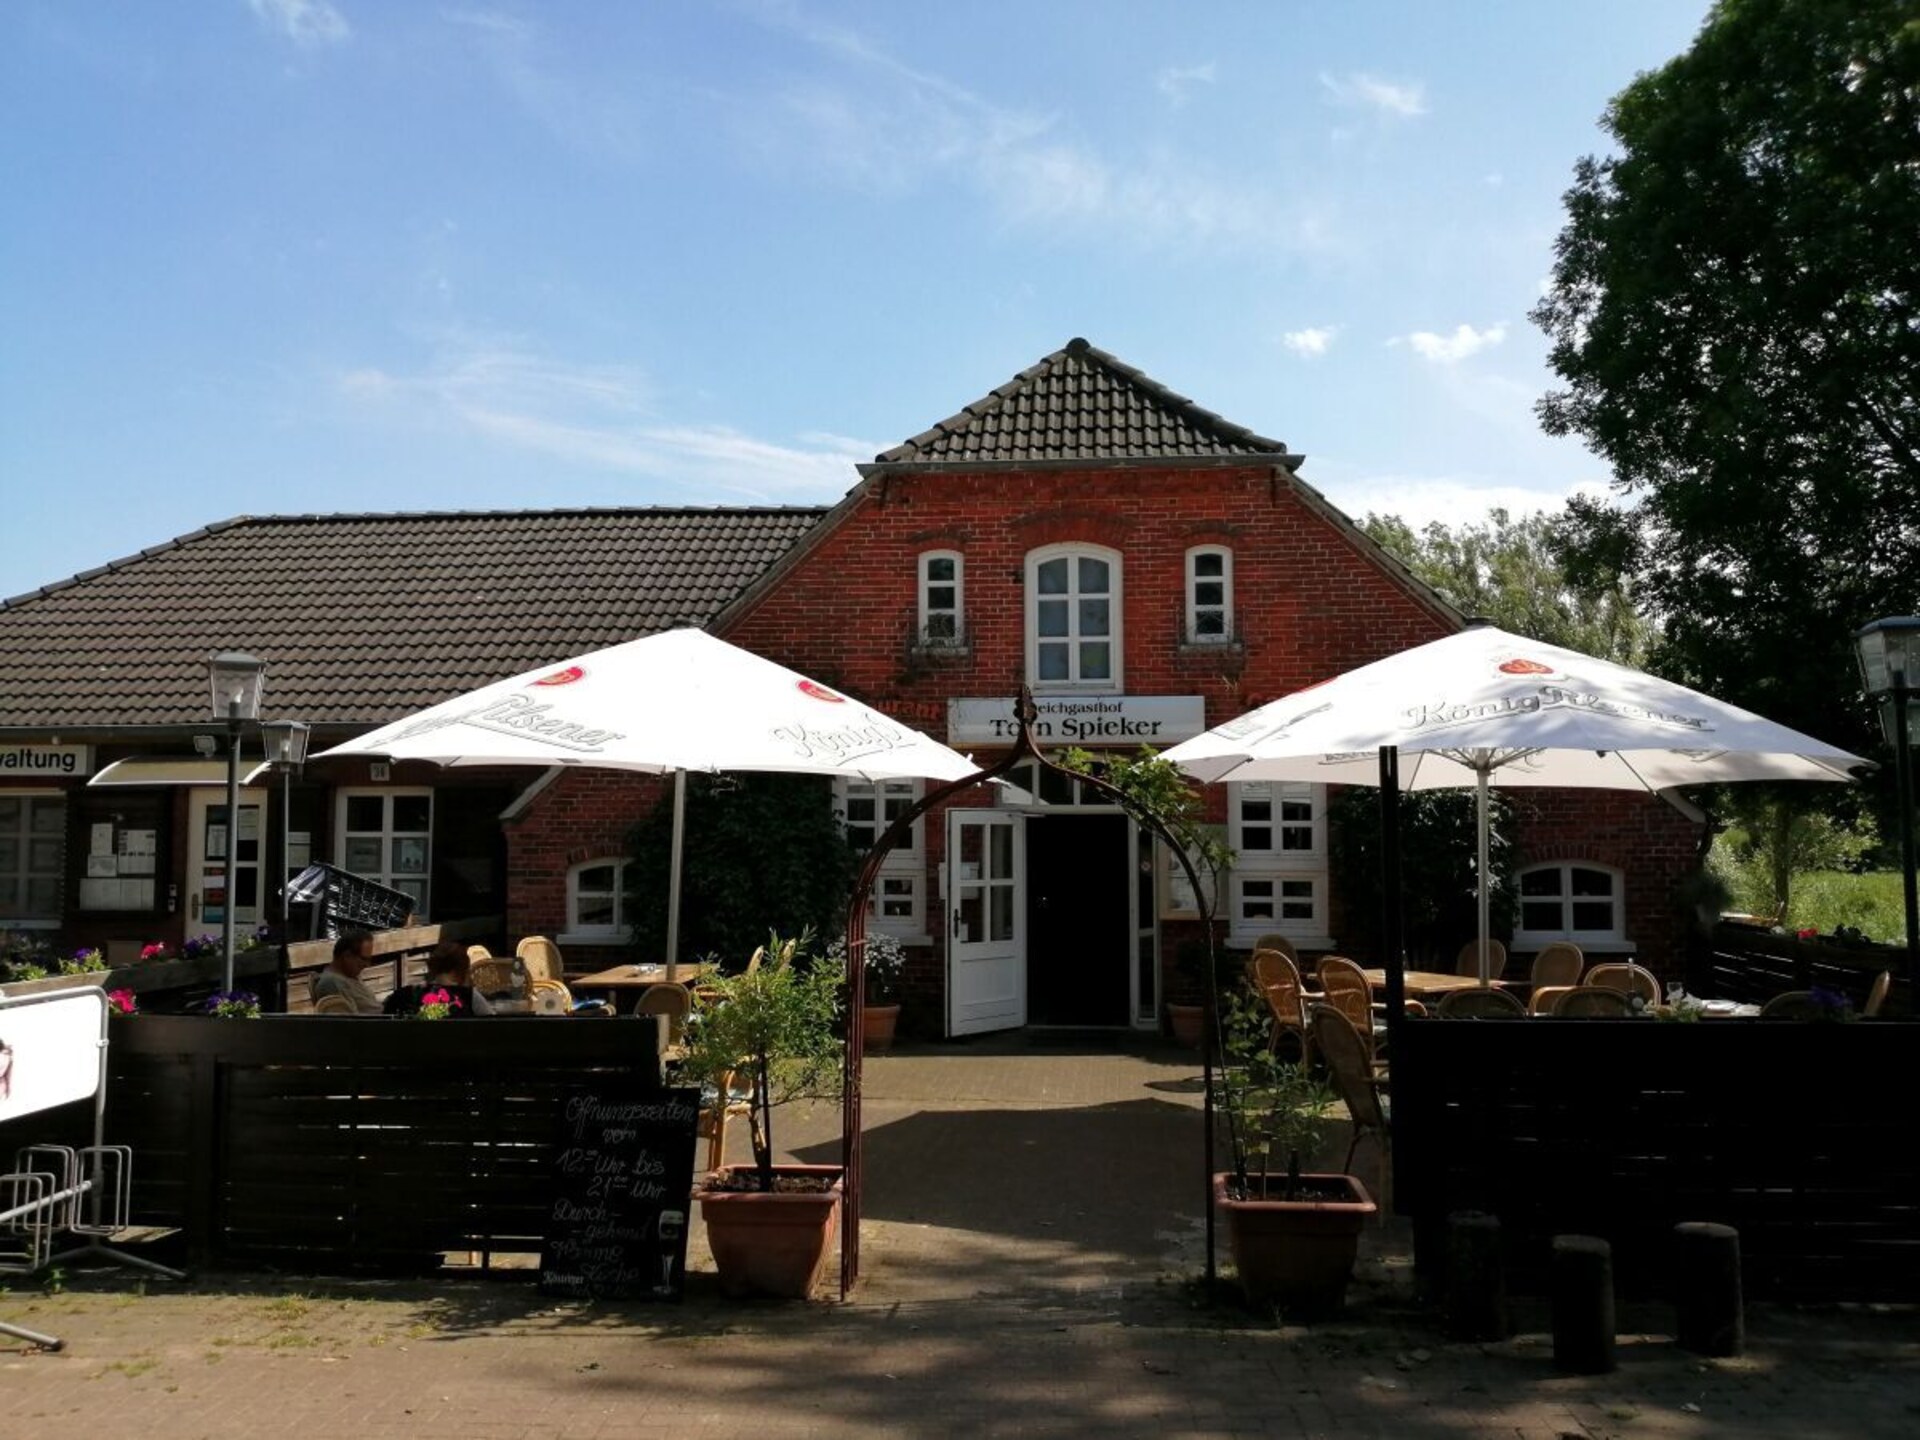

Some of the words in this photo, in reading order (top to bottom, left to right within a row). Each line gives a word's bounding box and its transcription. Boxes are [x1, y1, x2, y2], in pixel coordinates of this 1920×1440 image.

[482, 692, 627, 746] Pilsener
[1037, 702, 1123, 716] eichgasthof
[989, 718, 1052, 737] Ton
[1061, 717, 1162, 740] Spieker
[595, 1154, 627, 1175] Uhr
[632, 1148, 664, 1175] bis
[629, 1180, 668, 1200] Uhr
